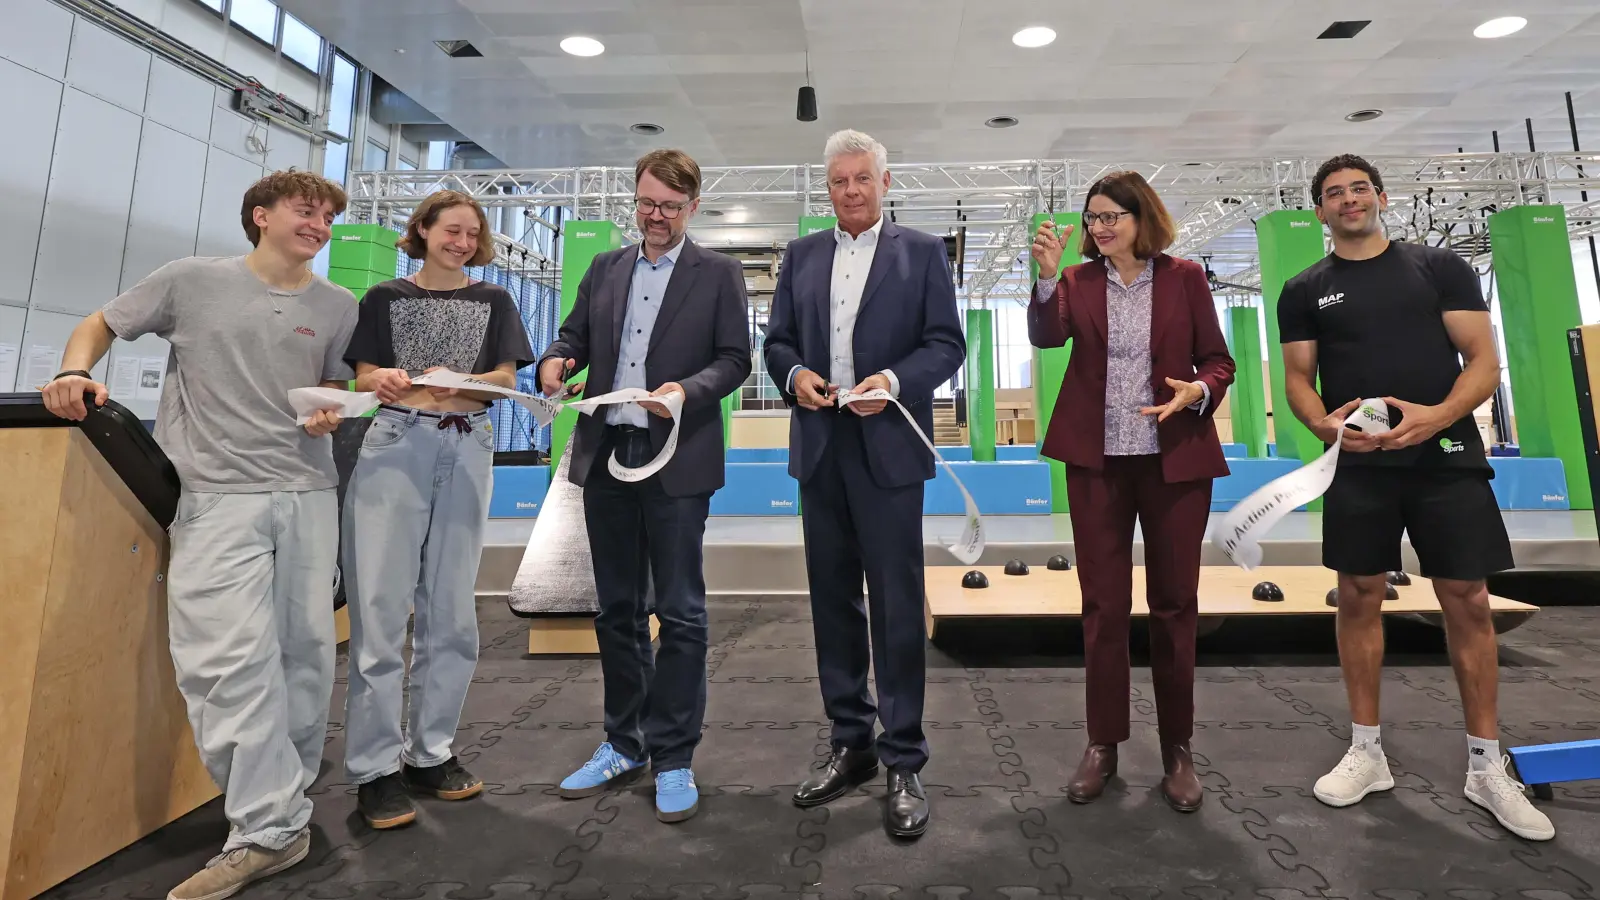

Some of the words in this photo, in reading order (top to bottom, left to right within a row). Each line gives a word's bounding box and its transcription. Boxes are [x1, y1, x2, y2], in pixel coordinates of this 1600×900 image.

[1318, 293, 1345, 306] MAP
[1363, 409, 1390, 427] Sport
[1443, 444, 1465, 453] Sports
[1232, 501, 1273, 541] Action
